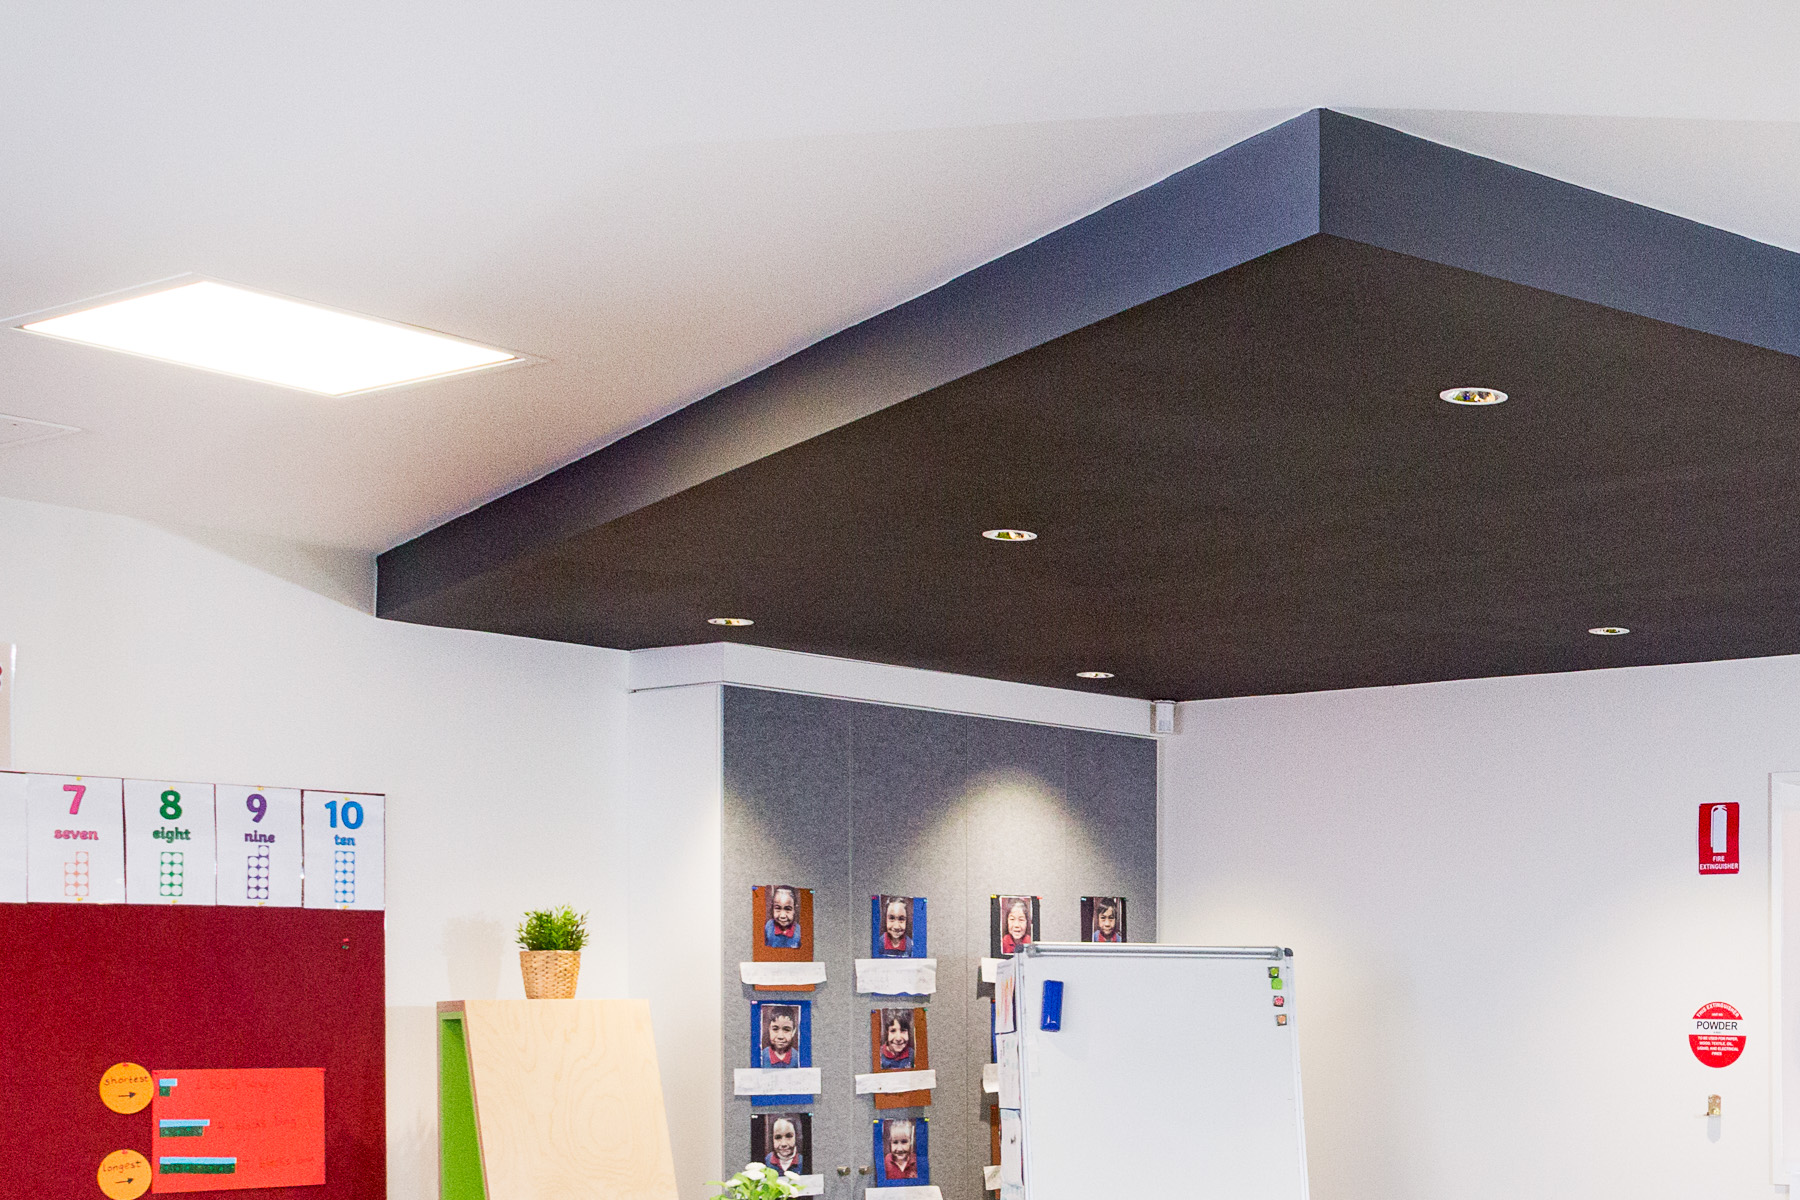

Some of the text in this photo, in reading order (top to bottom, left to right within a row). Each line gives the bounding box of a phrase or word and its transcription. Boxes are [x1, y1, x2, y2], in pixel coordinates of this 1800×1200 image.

[63, 784, 86, 815] 7
[159, 790, 182, 820] 8
[246, 794, 267, 823] 9
[325, 800, 364, 829] 10
[54, 828, 99, 841] seven
[152, 827, 191, 844] eight
[244, 830, 275, 844] nine
[334, 834, 356, 846] ten
[1696, 1020, 1738, 1030] POWDER
[104, 1075, 149, 1086] shortest
[102, 1160, 142, 1173] longest
